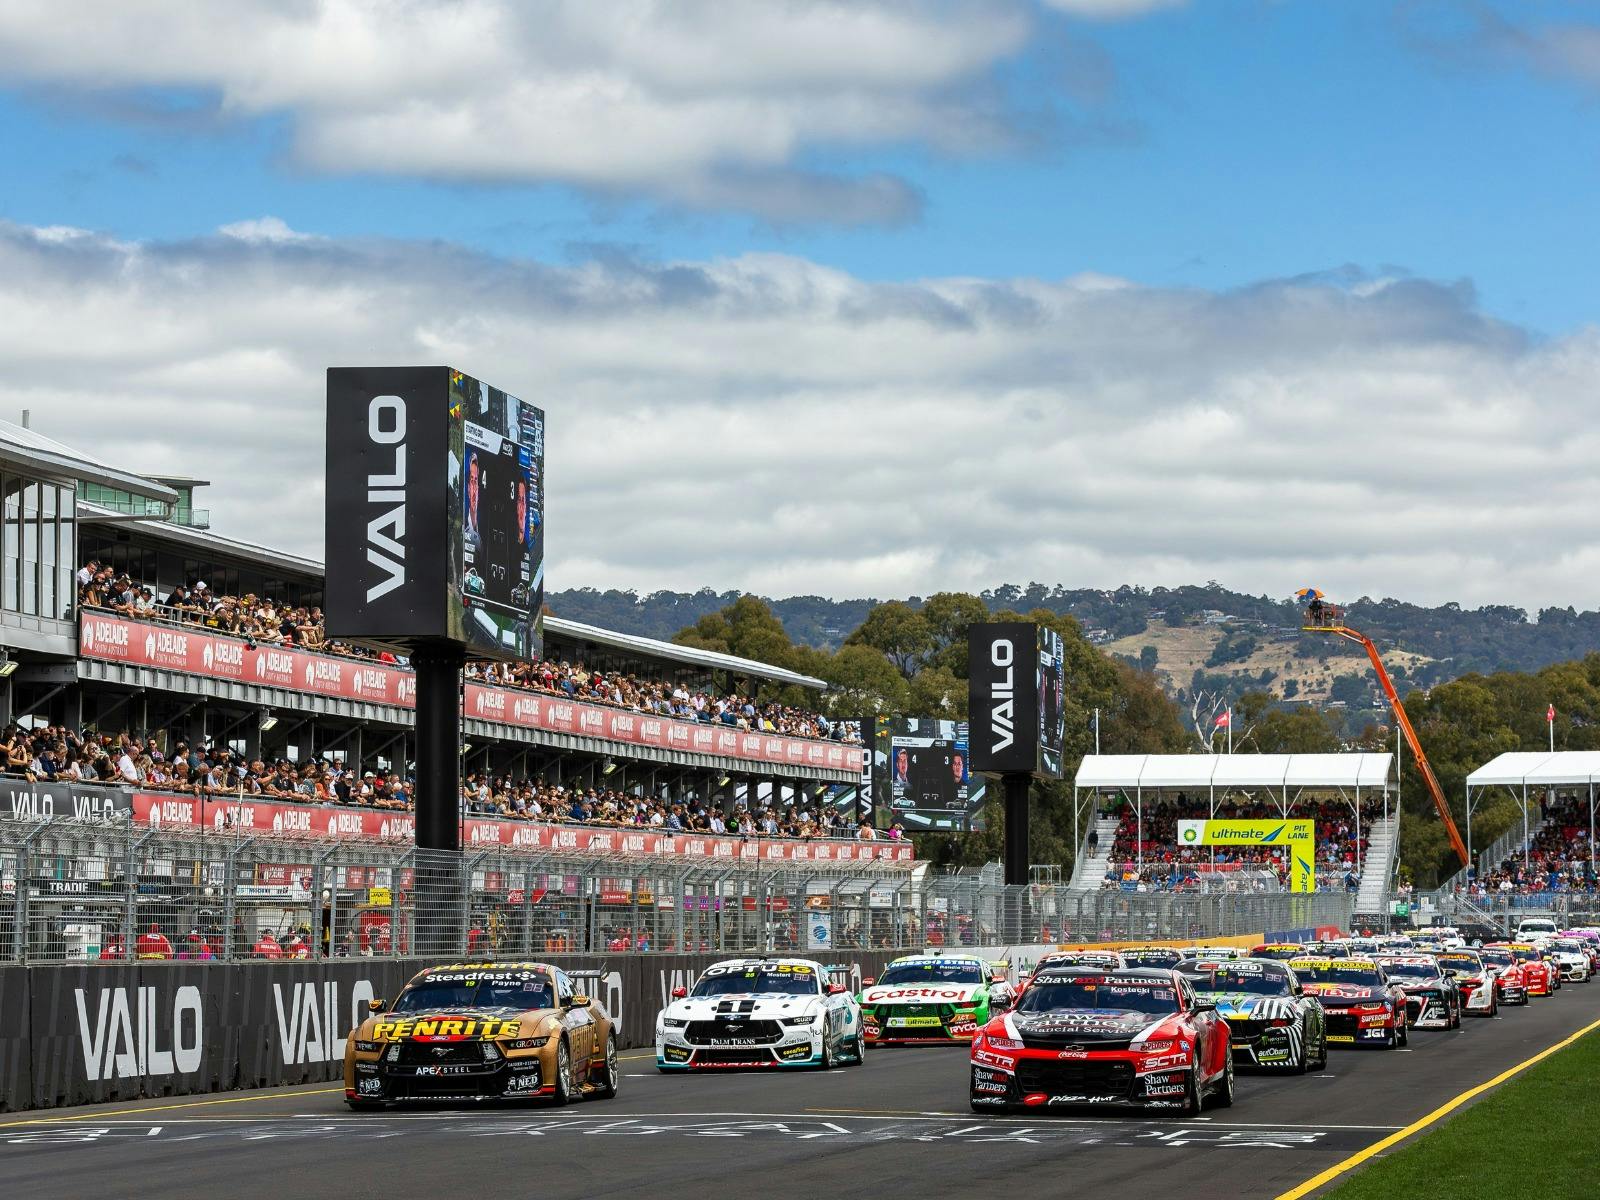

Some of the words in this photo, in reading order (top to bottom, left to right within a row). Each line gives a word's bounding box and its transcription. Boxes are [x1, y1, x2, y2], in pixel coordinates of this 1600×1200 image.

[482, 470, 487, 489] 4
[366, 395, 407, 604] VAILO
[510, 481, 515, 500] 3
[95, 621, 128, 646] ADELAIDE
[157, 631, 187, 656] ADELAIDE
[215, 642, 243, 665] ADELAIDE
[266, 652, 293, 674] ADELAIDE
[316, 661, 341, 682] ADELAIDE
[363, 670, 386, 689] ADELAIDE
[991, 638, 1014, 755] VAILO
[860, 748, 873, 815] VAILO
[10, 790, 54, 823] VAILO
[73, 795, 114, 822] VAILO
[162, 801, 193, 823] ADELAIDE
[284, 810, 311, 831] ADELAIDE
[338, 814, 362, 833] ADELAIDE
[1212, 828, 1264, 839] ultimate
[425, 972, 513, 983] Steadfast
[1111, 986, 1150, 994] Kostecki
[731, 1000, 742, 1013] 1
[272, 979, 375, 1065] VAILO
[373, 1020, 523, 1041] PENRITE
[949, 1022, 978, 1034] RYCO
[74, 985, 203, 1081] VAILO
[711, 1038, 729, 1046] PALM
[732, 1038, 756, 1046] TRANS
[975, 1050, 1015, 1067] SCTR
[1144, 1053, 1188, 1069] SCTR
[416, 1065, 443, 1076] APEX
[443, 1066, 471, 1074] STEEL
[518, 1075, 539, 1088] NED
[975, 1078, 1007, 1092] Partners
[1146, 1084, 1185, 1096] Partners
